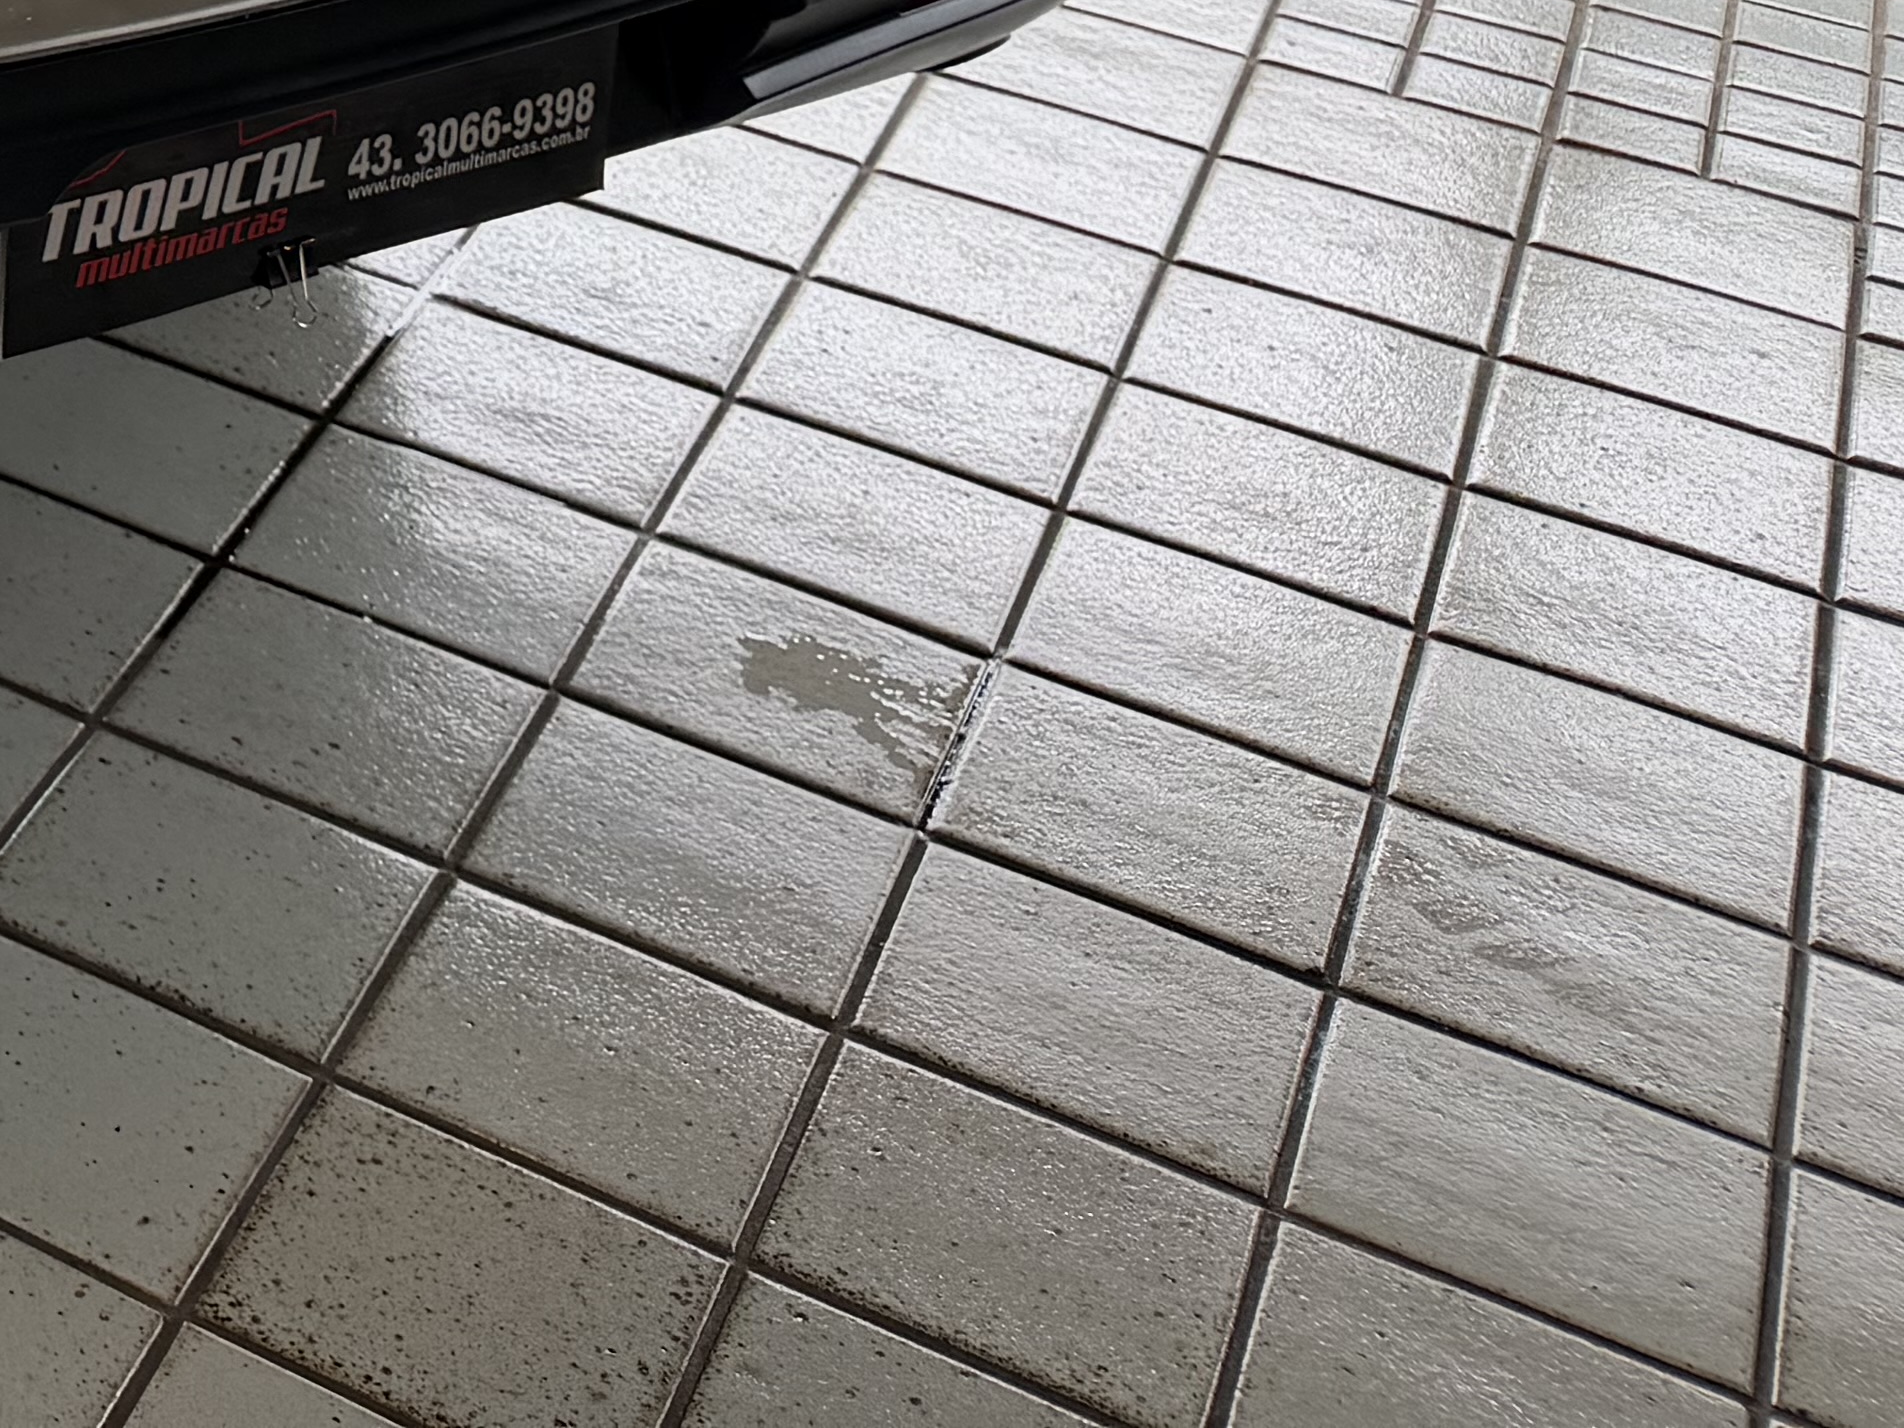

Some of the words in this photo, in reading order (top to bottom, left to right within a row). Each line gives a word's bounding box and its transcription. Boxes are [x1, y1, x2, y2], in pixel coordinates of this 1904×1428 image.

[347, 123, 591, 202] www.tropicalmultimarcas.com.br
[415, 81, 596, 165] 3066-9398
[42, 136, 325, 263] TROPICAL
[76, 207, 288, 289] multimarcas
